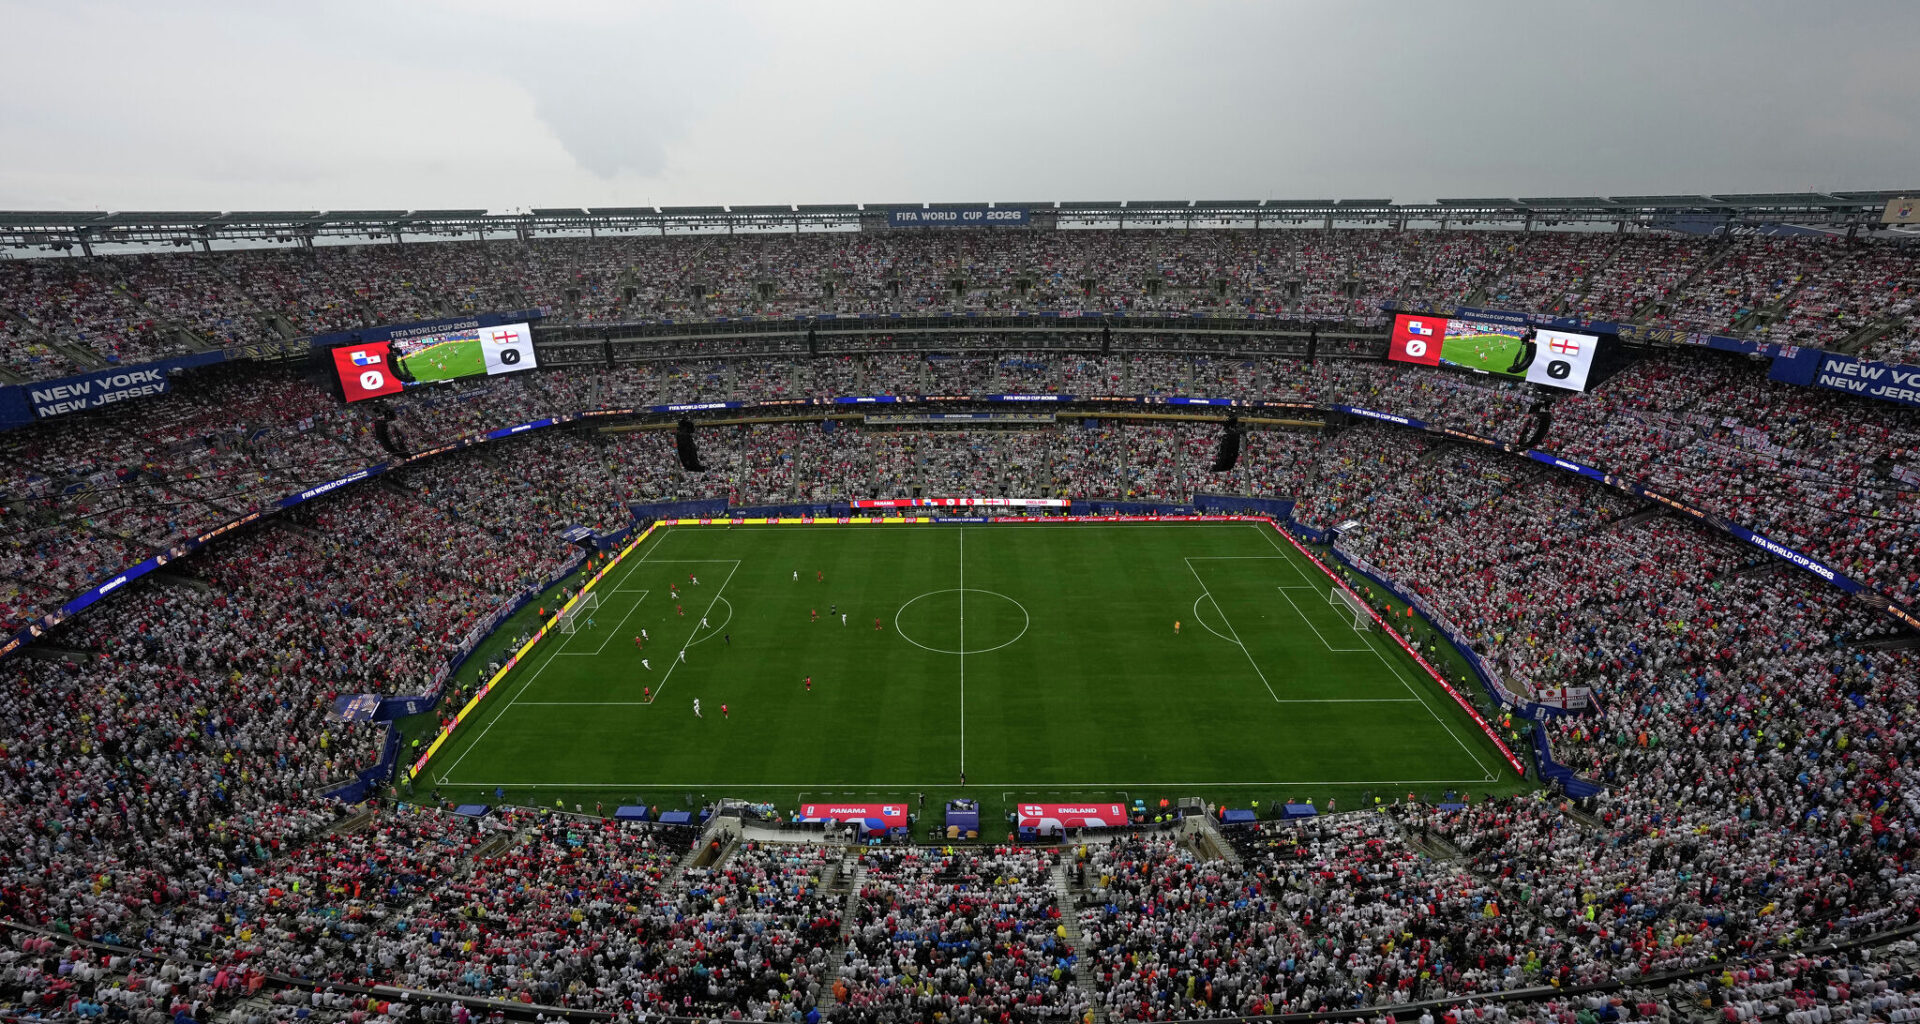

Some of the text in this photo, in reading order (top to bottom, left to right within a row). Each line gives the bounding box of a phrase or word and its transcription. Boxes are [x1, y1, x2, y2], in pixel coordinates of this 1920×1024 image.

[896, 211, 1021, 220] FIFA WORLD CUP 2026
[390, 321, 479, 338] FIFA WORLD CUP 2026
[500, 348, 520, 365] 0
[1405, 339, 1427, 357] 0
[1546, 360, 1571, 379] 0
[1825, 360, 1885, 380] NEW
[31, 368, 163, 404] NEW YORK
[359, 370, 384, 390] 0
[1820, 375, 1868, 392] NEW
[38, 382, 165, 418] NEW JERSEY
[1363, 410, 1380, 418] WORLD
[301, 490, 316, 499] FIFA
[315, 482, 336, 494] WORLD
[347, 471, 368, 481] 2026
[1751, 534, 1834, 580] FIFA WORLD CUP 2026
[1449, 689, 1474, 715] Budweiser
[1485, 725, 1510, 758] Budweiser
